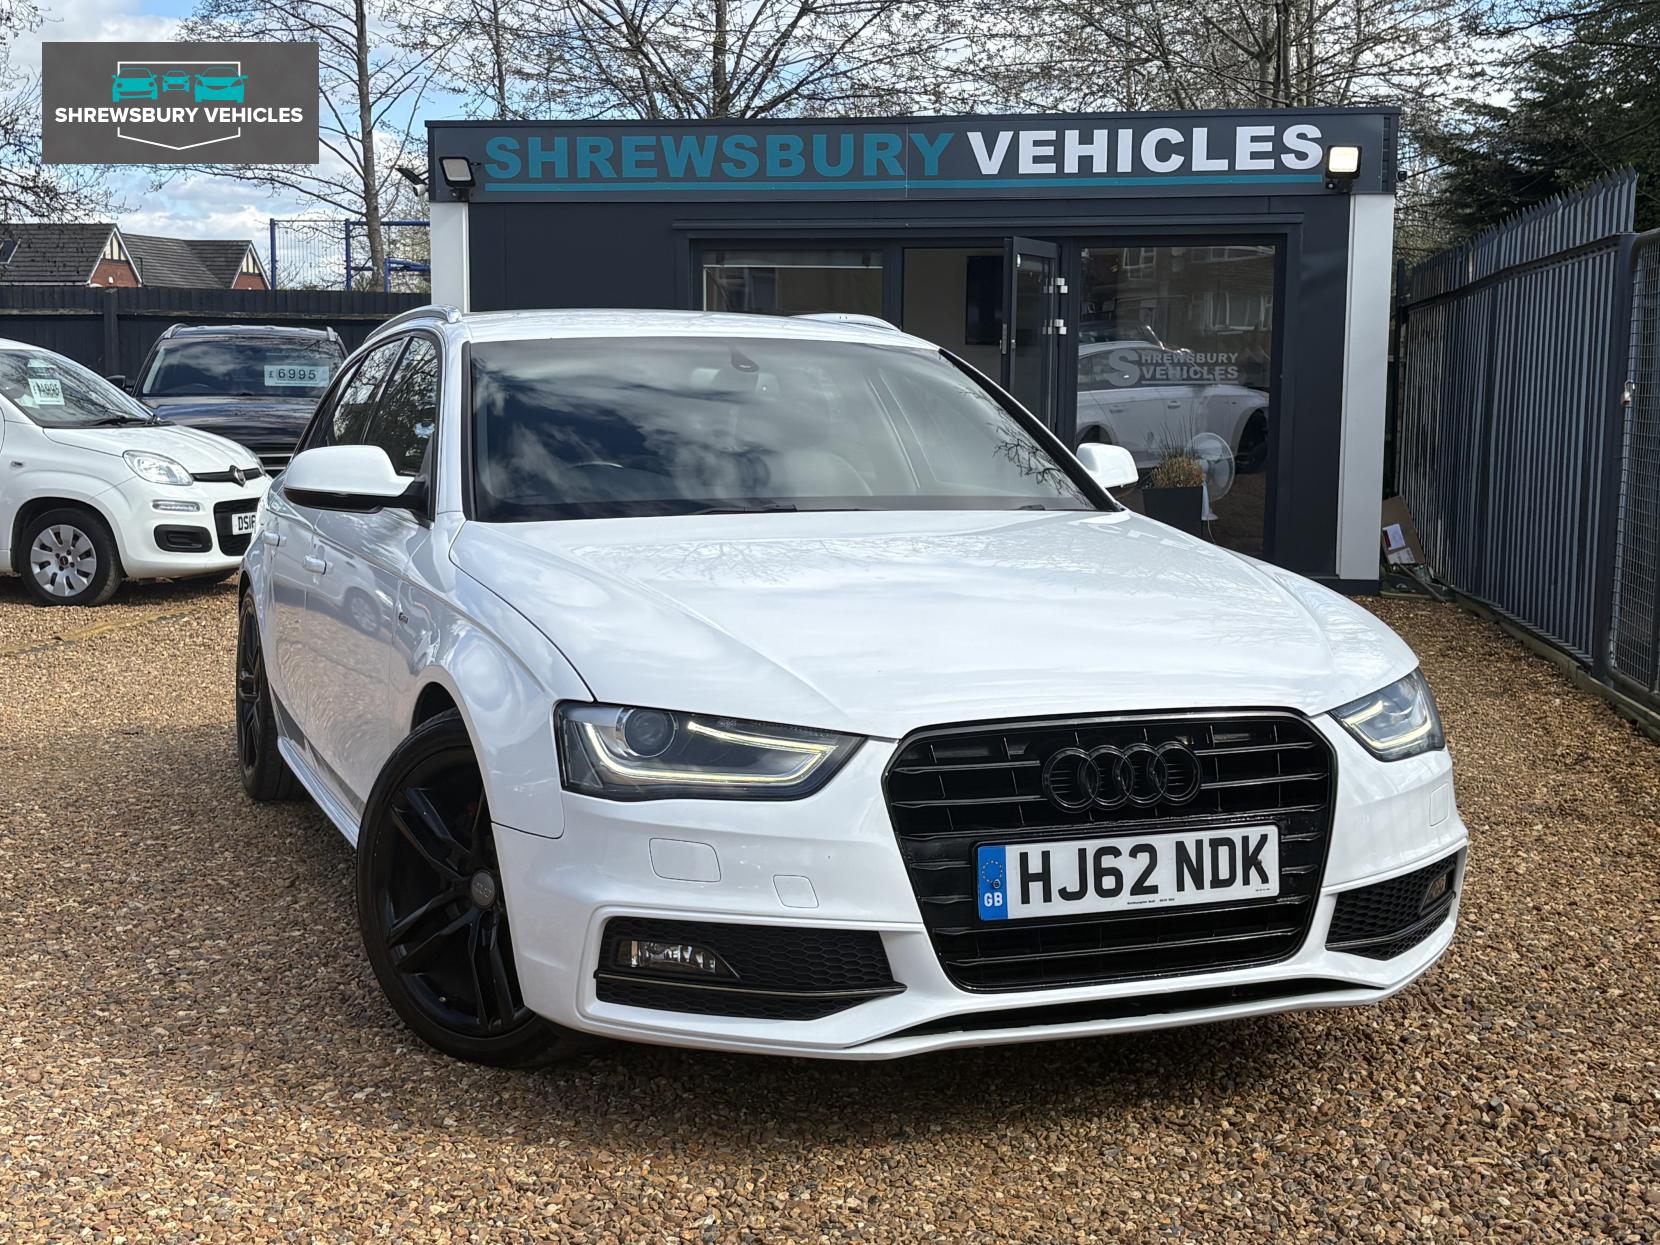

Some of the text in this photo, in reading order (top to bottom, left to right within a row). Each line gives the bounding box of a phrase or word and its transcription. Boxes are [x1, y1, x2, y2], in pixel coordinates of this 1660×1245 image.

[484, 123, 1323, 179] SHREWSBURY VEHICLES
[1104, 349, 1238, 387] SHREWSBURY
[1140, 366, 1239, 379] VEHICLES
[1019, 833, 1270, 905] HJ62 NDK
[983, 892, 1003, 907] GB
